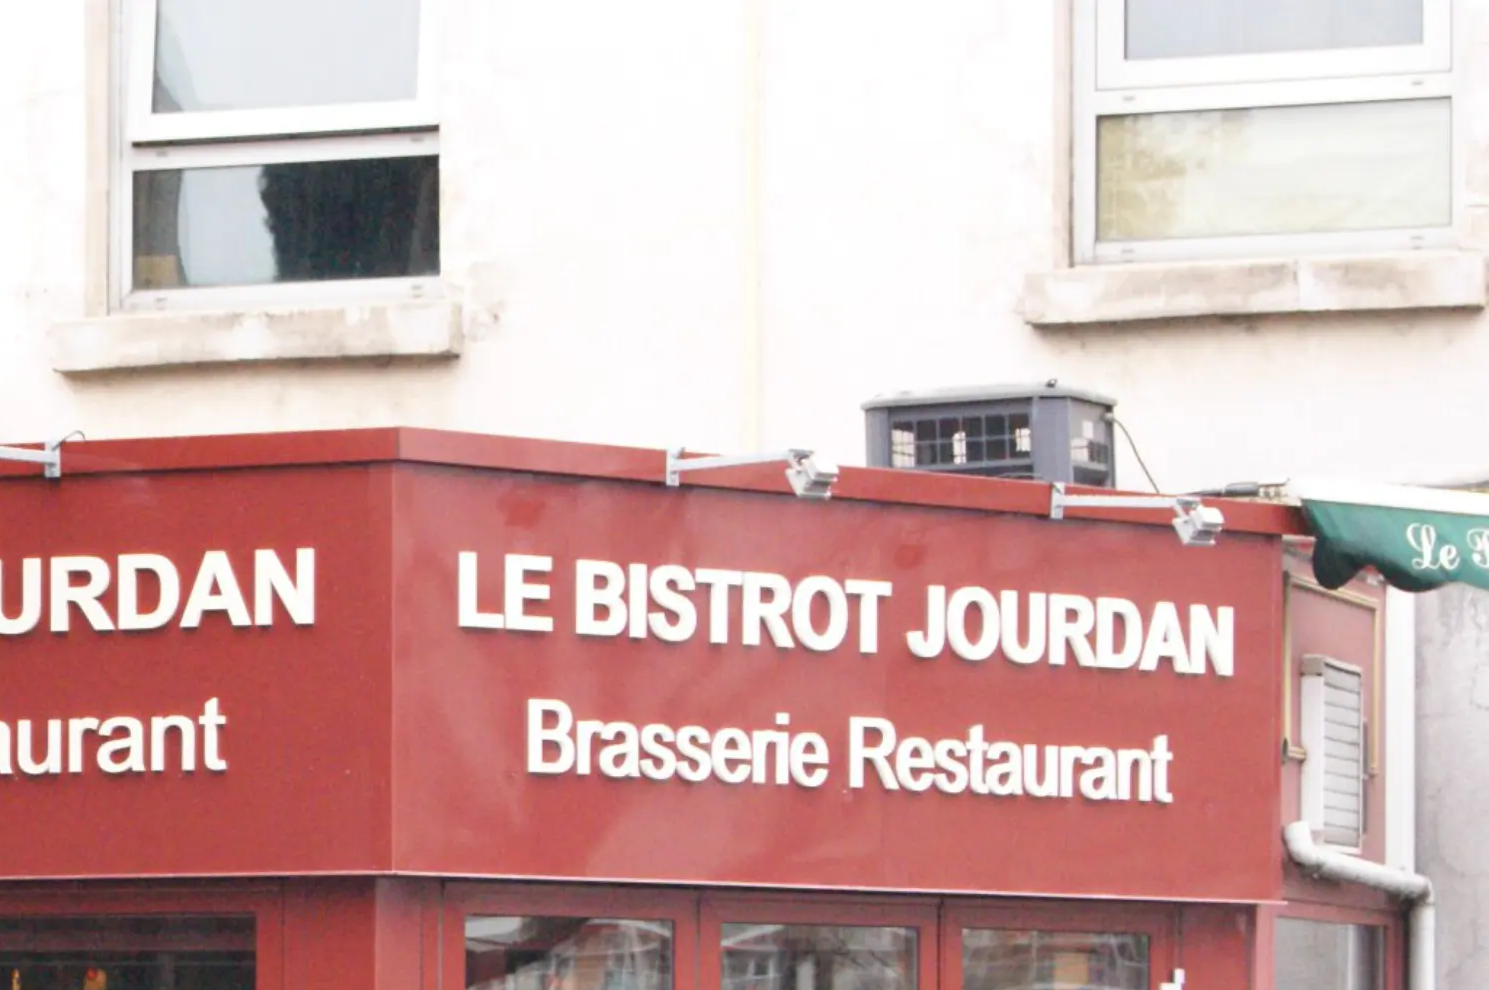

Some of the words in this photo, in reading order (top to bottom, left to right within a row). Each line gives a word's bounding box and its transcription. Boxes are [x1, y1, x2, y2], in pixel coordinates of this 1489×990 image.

[1406, 522, 1461, 571] Le
[456, 550, 555, 634] LE
[574, 558, 895, 657] BISTROT
[904, 584, 1236, 678] JOURDAN
[526, 698, 831, 790] Brasserie
[847, 715, 1175, 804] Restaurant
